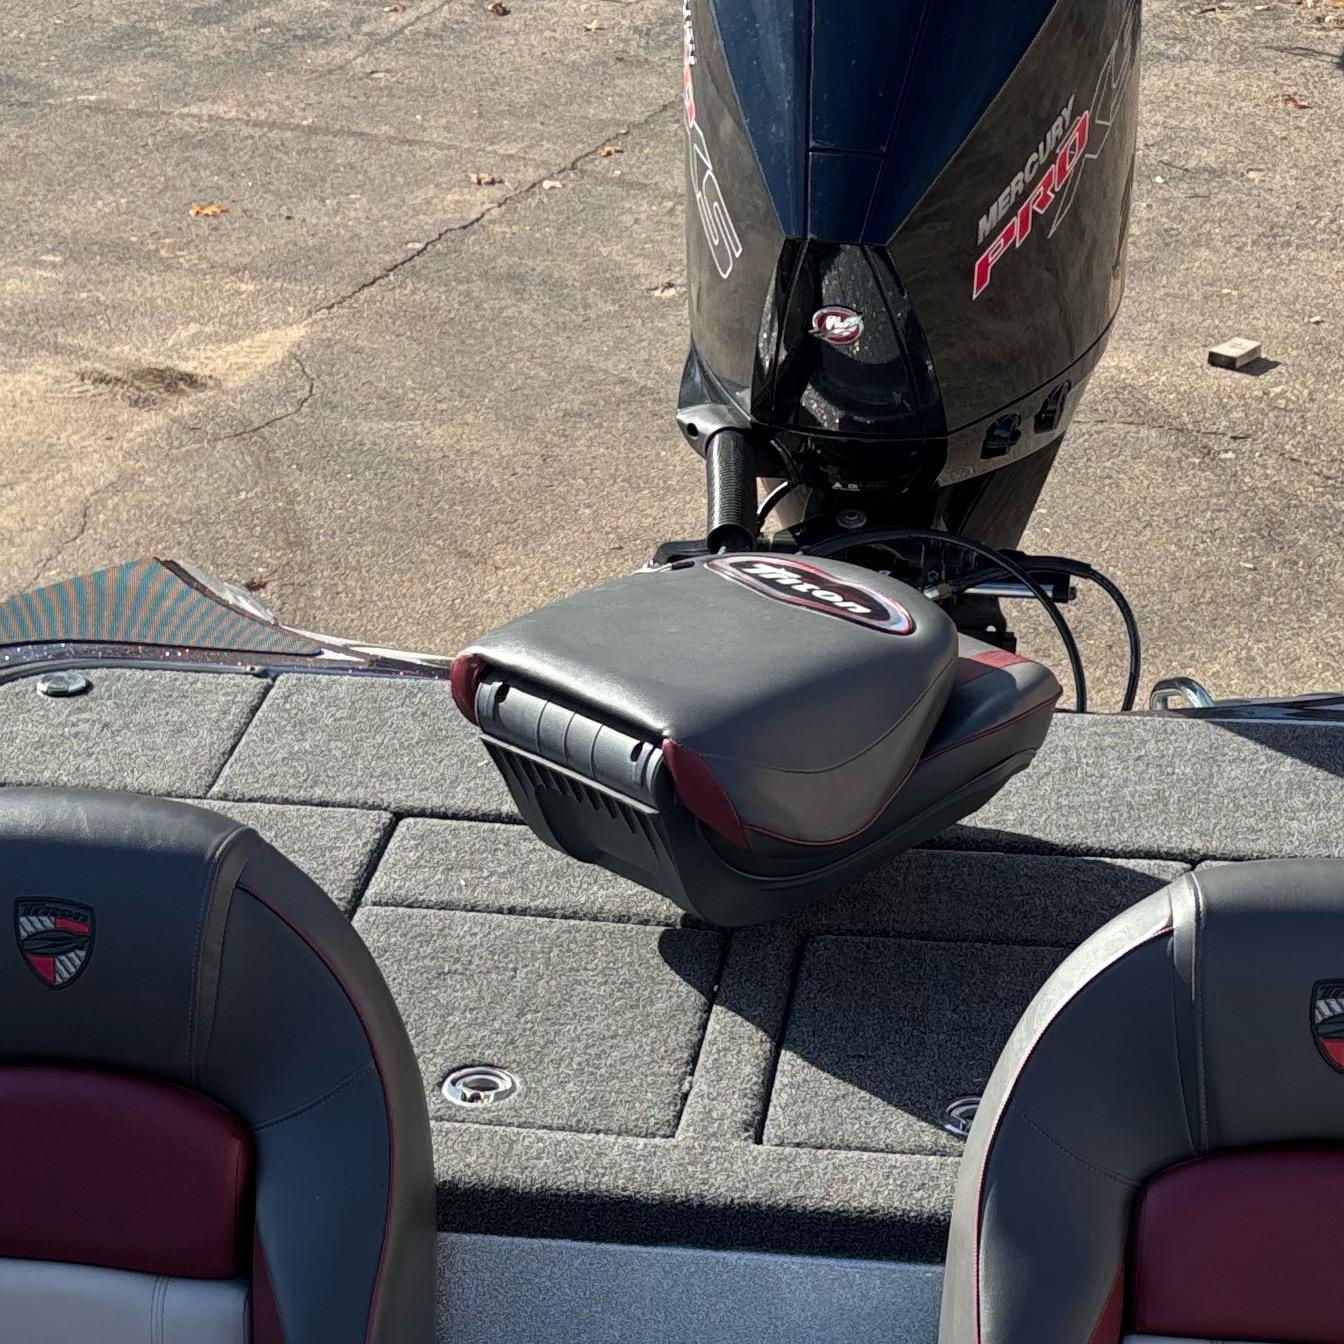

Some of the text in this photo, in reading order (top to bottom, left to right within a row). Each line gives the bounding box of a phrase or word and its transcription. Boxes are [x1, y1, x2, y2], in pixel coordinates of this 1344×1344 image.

[972, 110, 1090, 301] PRO
[977, 95, 1075, 245] MERCURY
[742, 563, 872, 614] Triton
